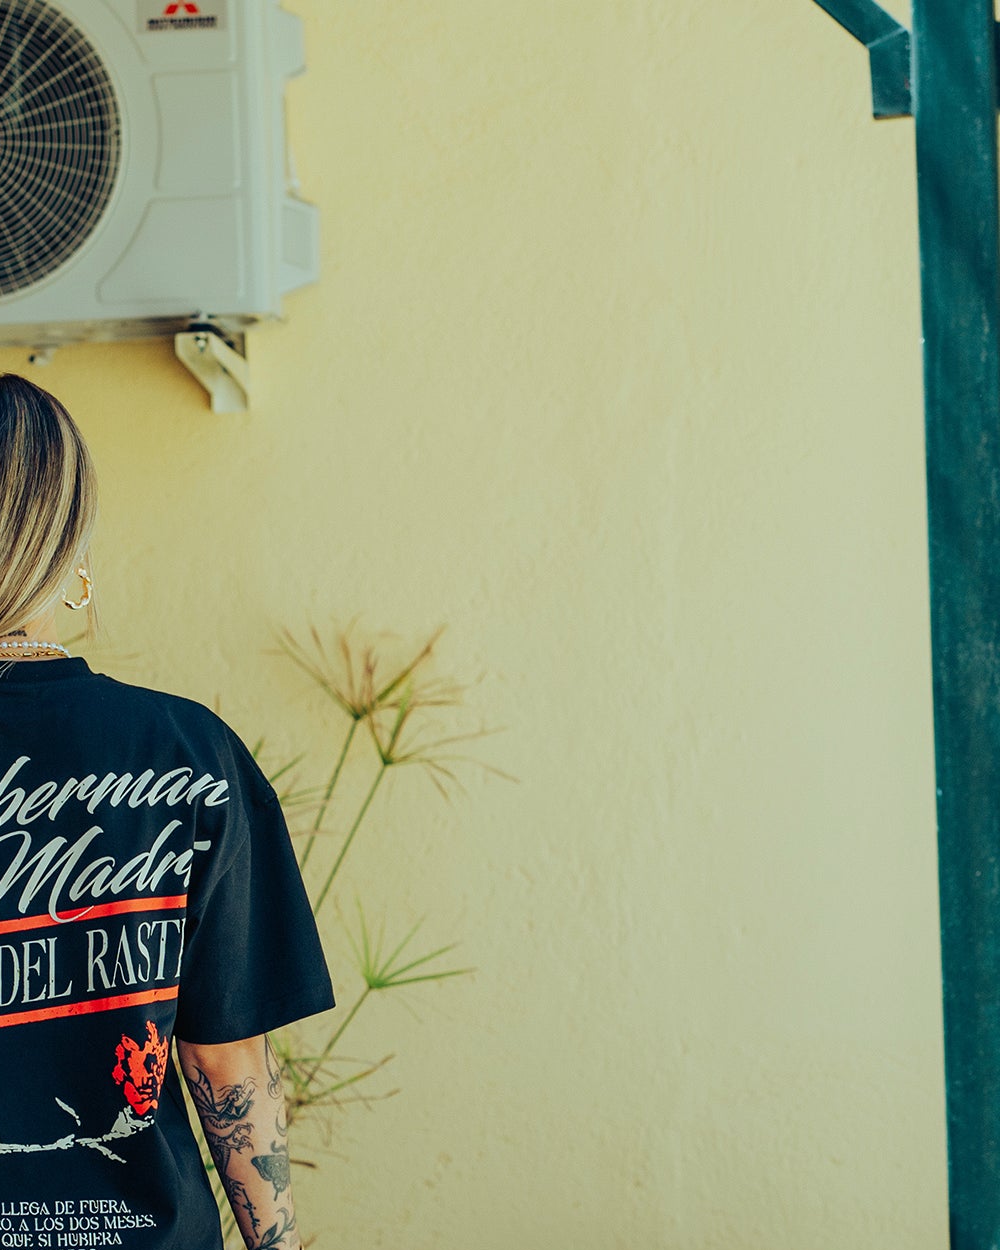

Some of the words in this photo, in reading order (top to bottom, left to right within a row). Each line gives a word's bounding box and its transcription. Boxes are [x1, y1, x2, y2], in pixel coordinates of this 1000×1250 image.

[1, 1201, 50, 1216] LLEGA
[54, 1200, 75, 1215] DE
[18, 1218, 30, 1232] A
[34, 1216, 65, 1231] LOS
[69, 1216, 100, 1231] DOS
[1, 1232, 34, 1247] QUE
[38, 1233, 52, 1247] SI
[57, 1231, 123, 1247] HUBIERA
